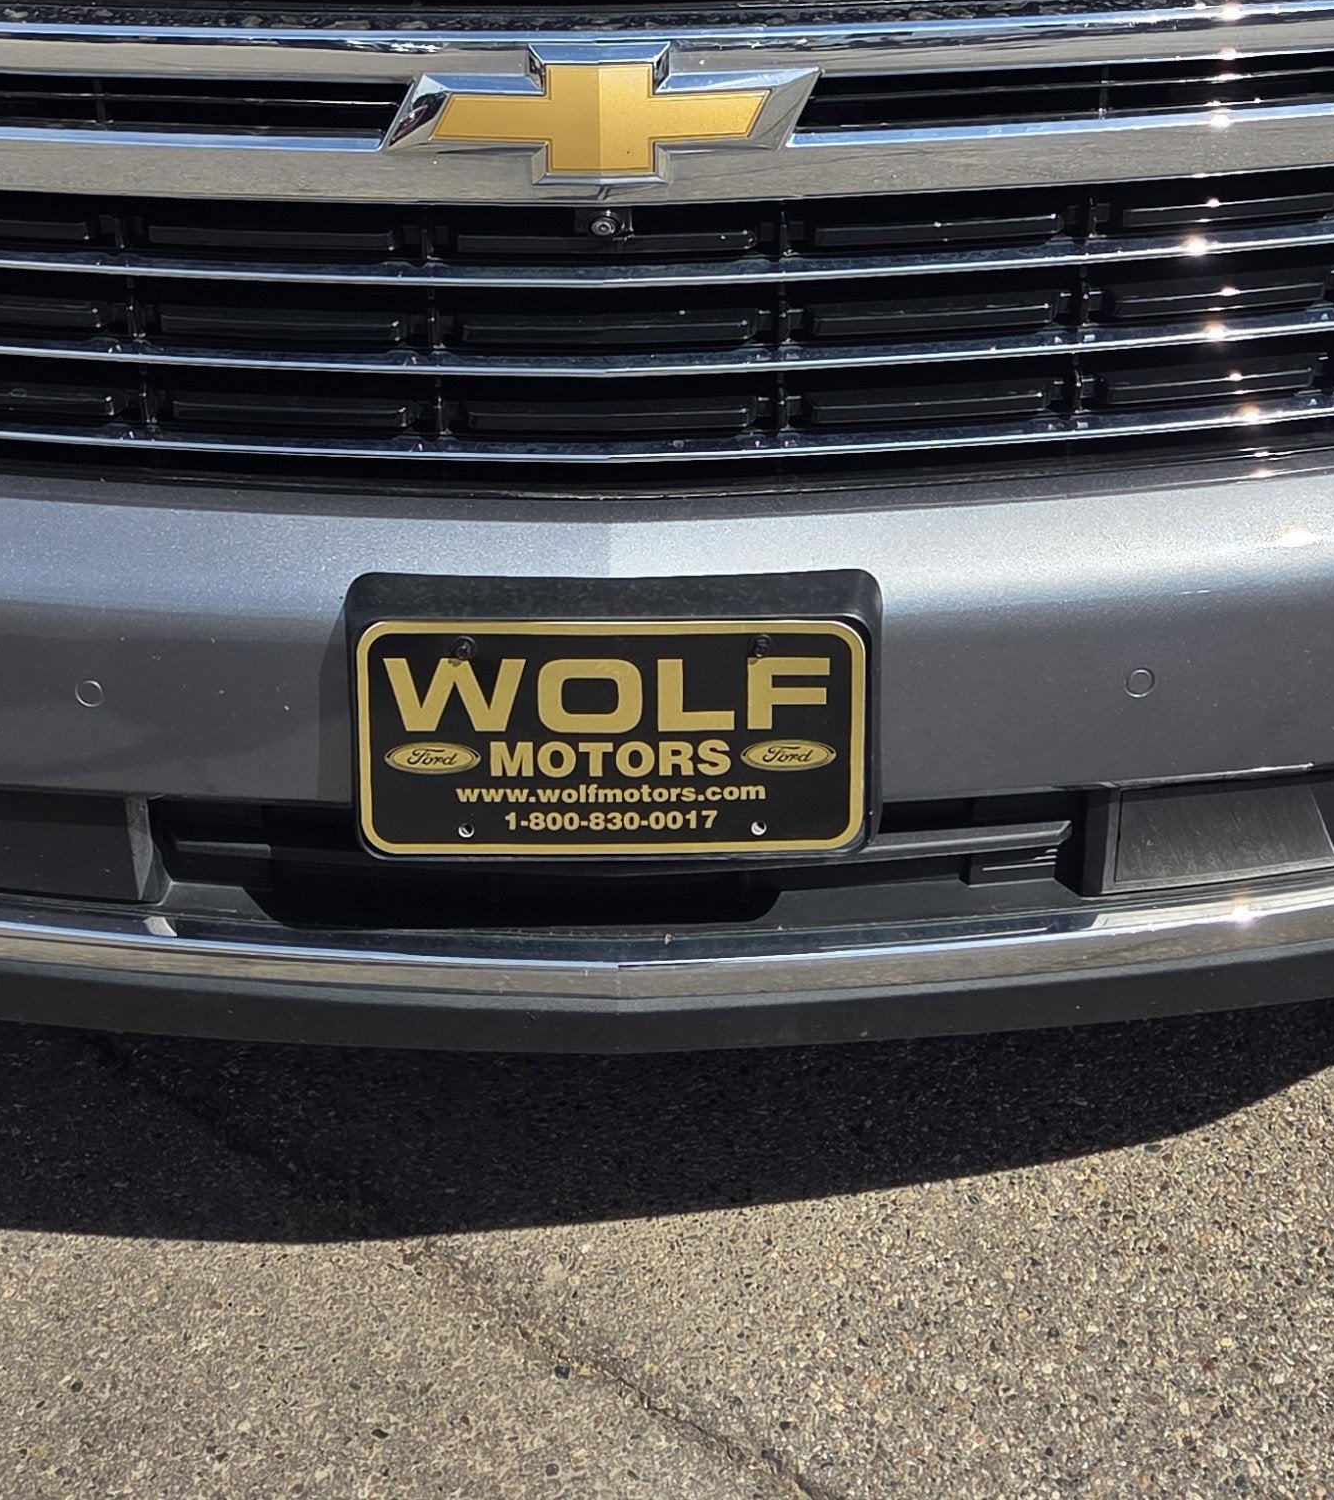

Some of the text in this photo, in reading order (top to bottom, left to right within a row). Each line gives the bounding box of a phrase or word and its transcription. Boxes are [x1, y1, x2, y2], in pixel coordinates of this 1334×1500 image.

[382, 657, 831, 734] WOLF
[489, 739, 732, 779] MOTORS
[455, 783, 767, 804] www.wolfmotors.com
[504, 809, 718, 832] 1-800-830-0017
